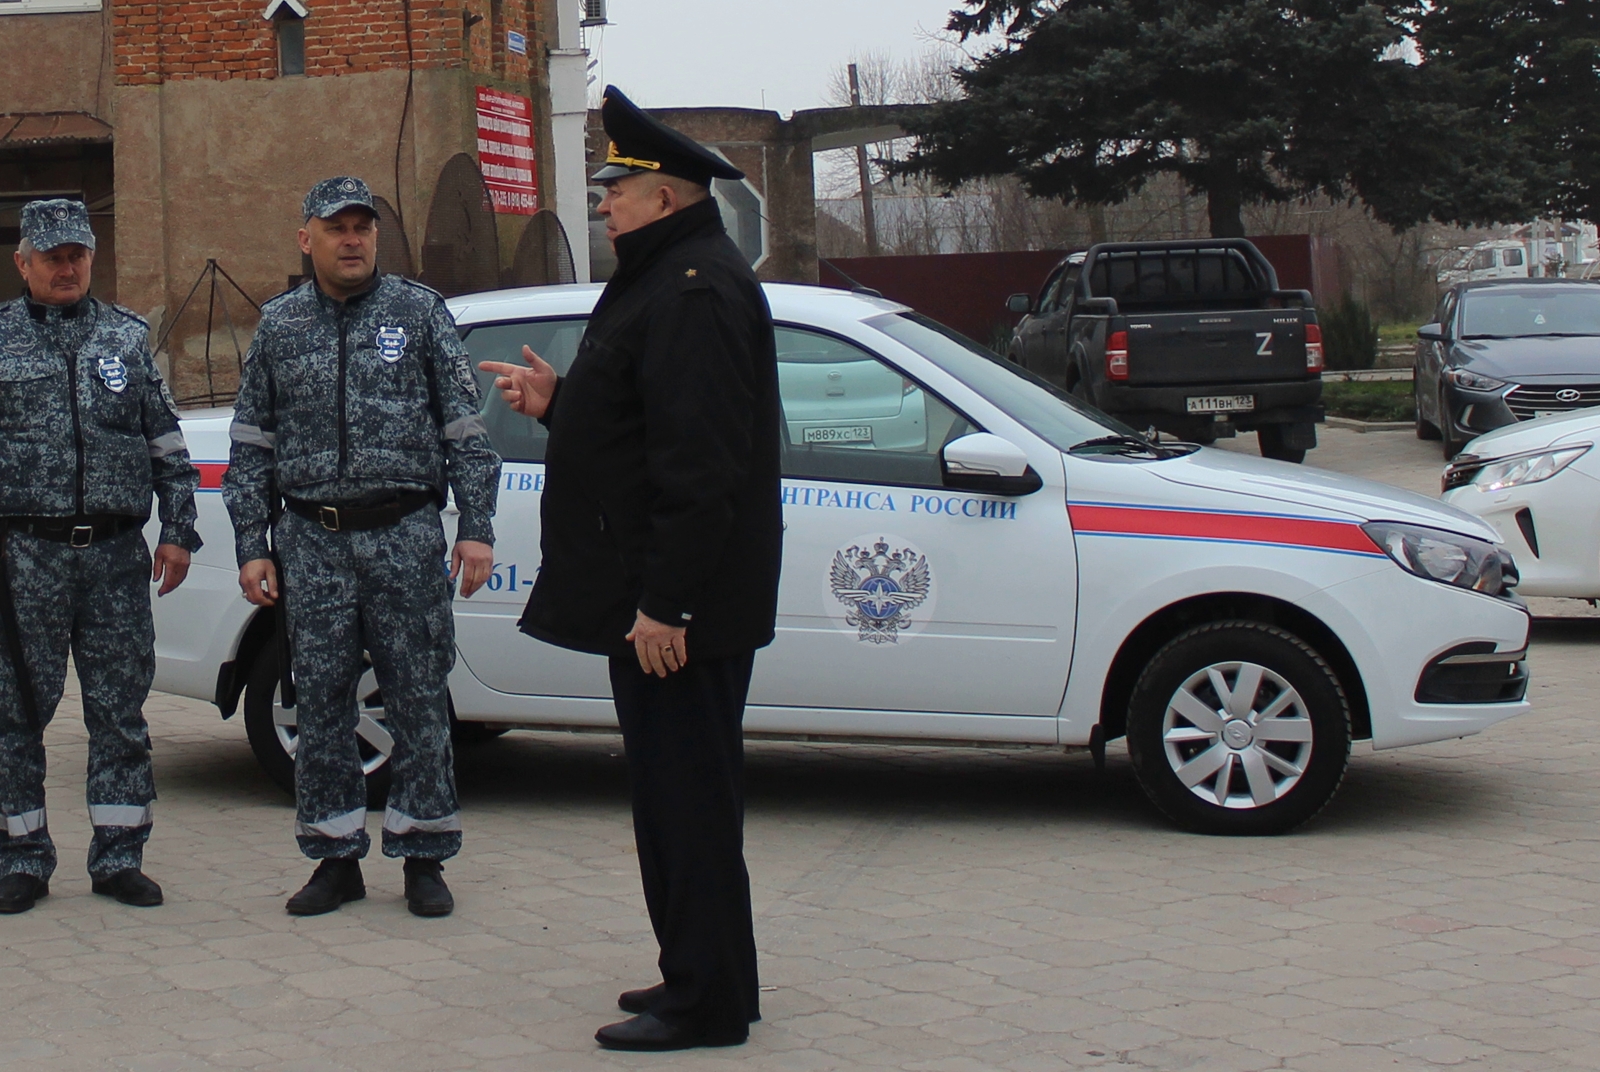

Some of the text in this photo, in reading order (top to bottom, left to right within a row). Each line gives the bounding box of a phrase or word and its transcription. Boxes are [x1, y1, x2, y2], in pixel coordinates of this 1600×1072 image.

[1255, 332, 1273, 356] Z
[1190, 398, 1233, 410] А111ВН
[807, 428, 869, 440] М889ХС 123
[502, 472, 1018, 520] ТВЕ НТРАНСА РОССИИ
[486, 563, 542, 592] 61-
